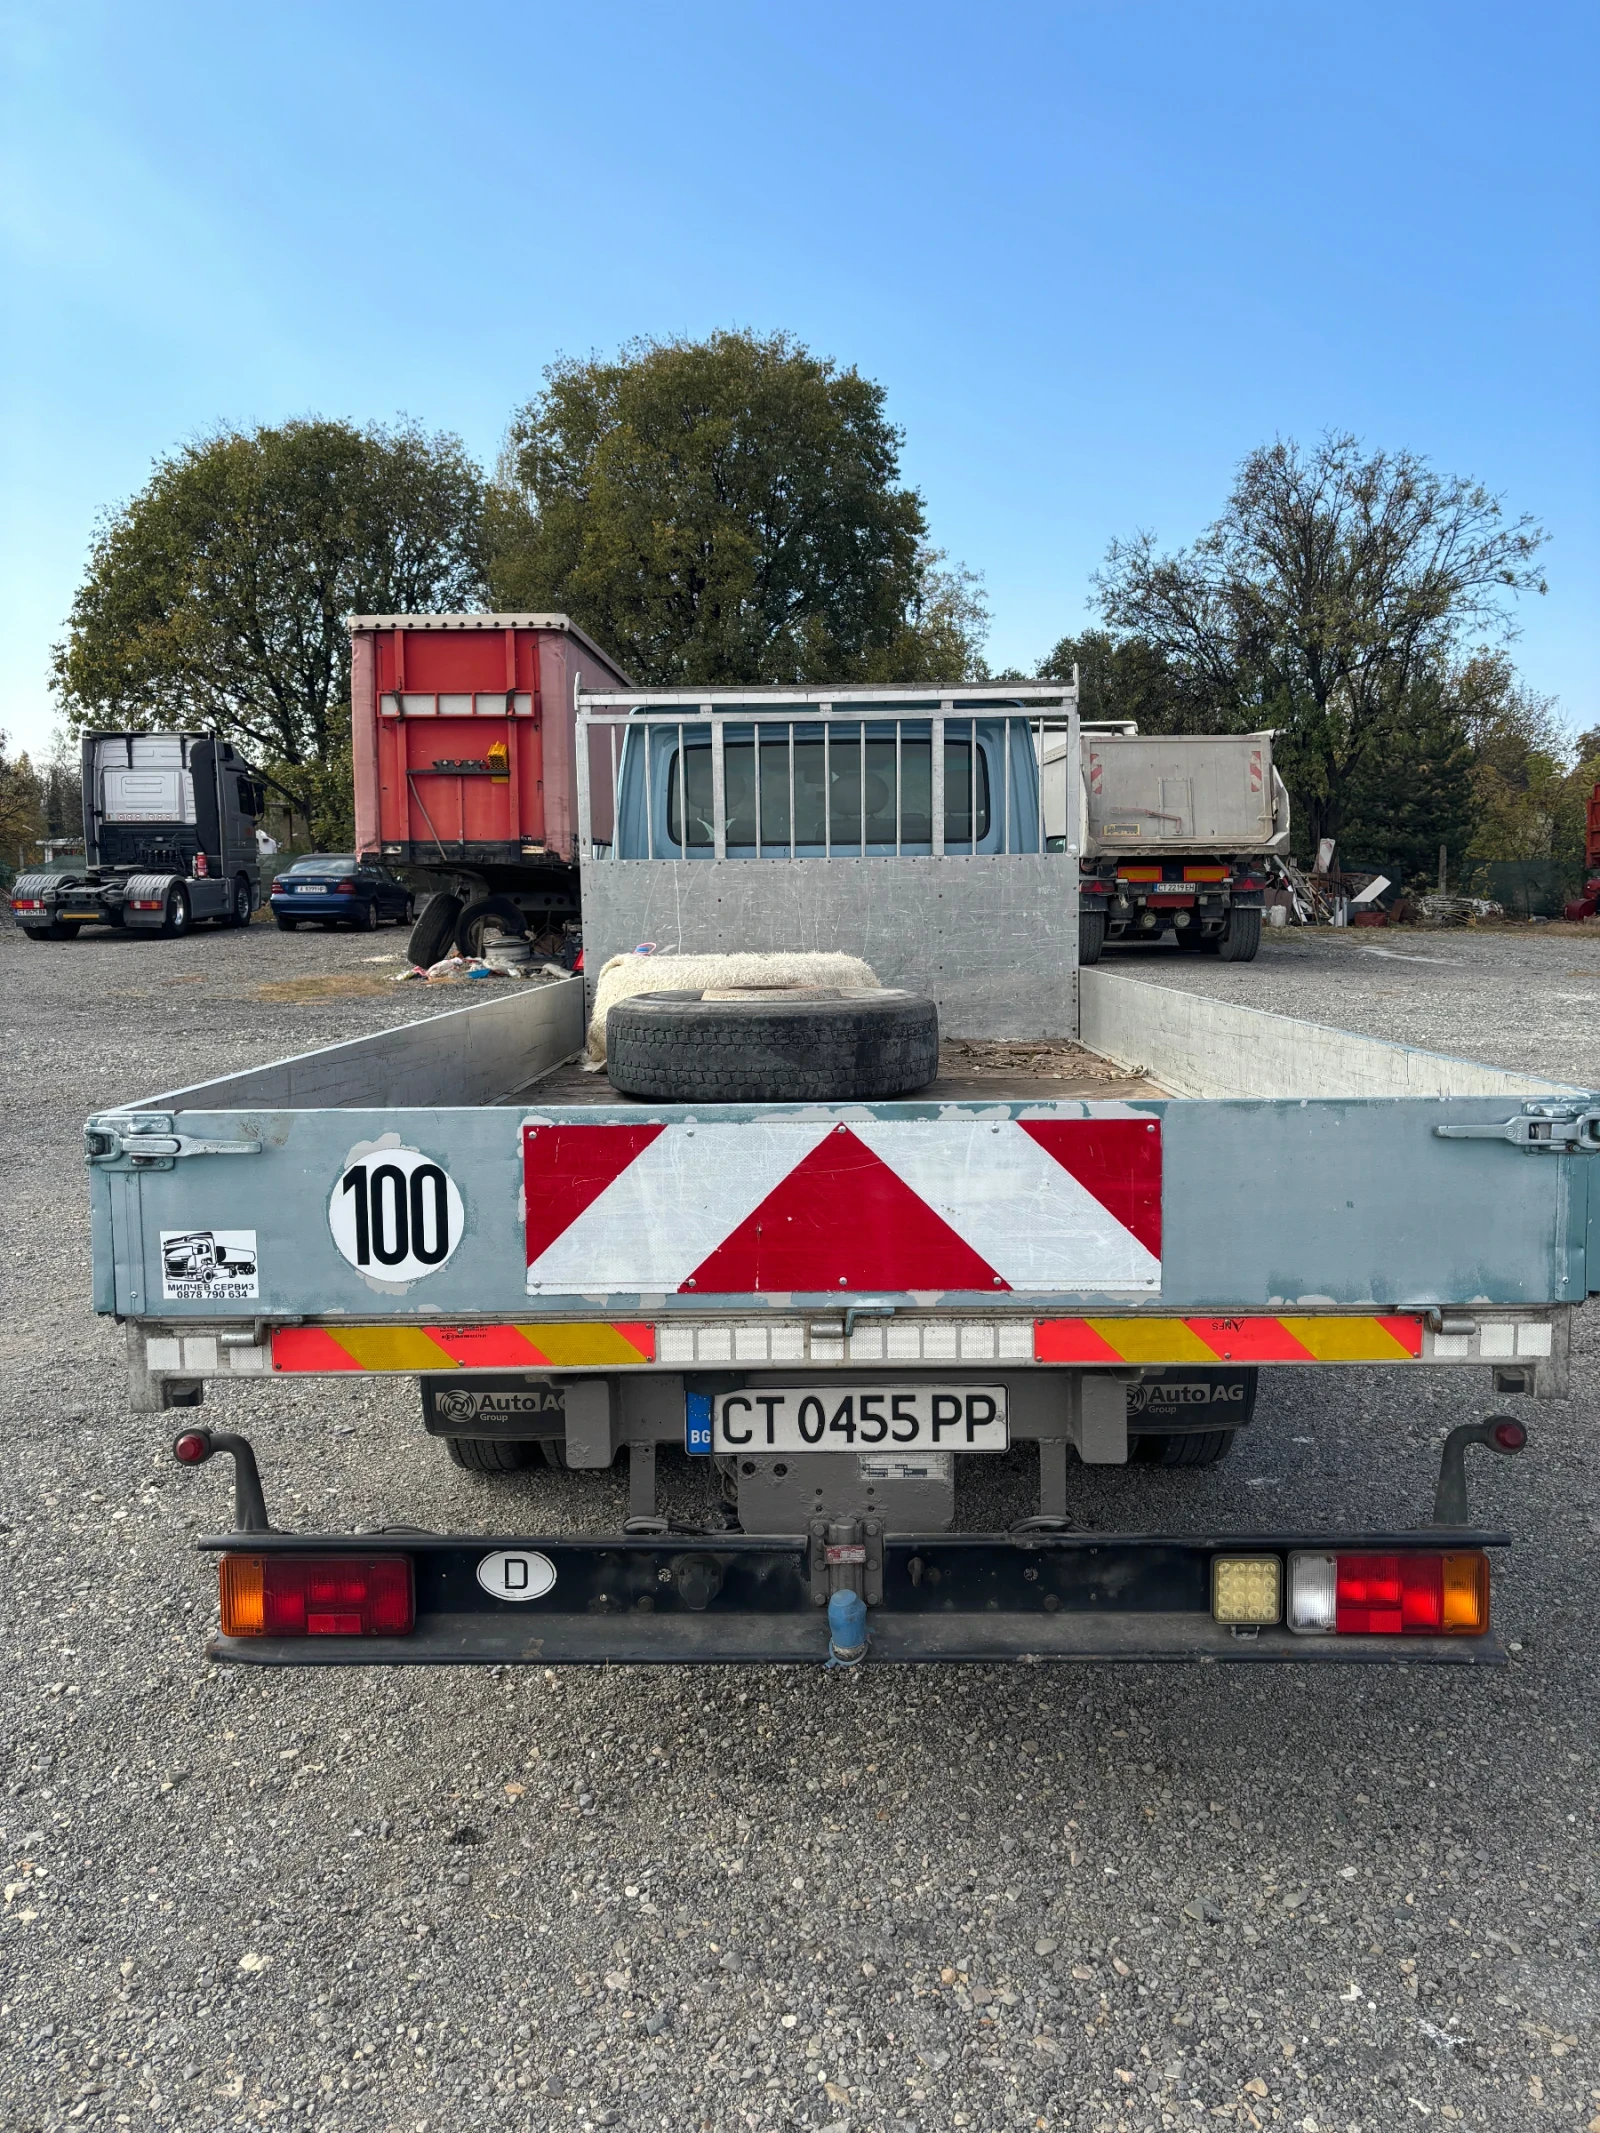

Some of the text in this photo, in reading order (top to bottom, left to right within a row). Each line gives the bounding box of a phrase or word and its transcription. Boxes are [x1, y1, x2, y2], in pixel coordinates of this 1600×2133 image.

[342, 1164, 449, 1265] 100
[176, 1290, 248, 1298] 0878 790 634
[213, 1283, 255, 1291] СЕРВИЗ
[1147, 1384, 1244, 1403] Auto AG
[480, 1394, 536, 1411] Auto
[1148, 1405, 1177, 1414] Group
[480, 1413, 508, 1422] Group
[722, 1394, 997, 1444] CT 0455 PP
[691, 1429, 711, 1444] BG
[505, 1558, 528, 1589] D
